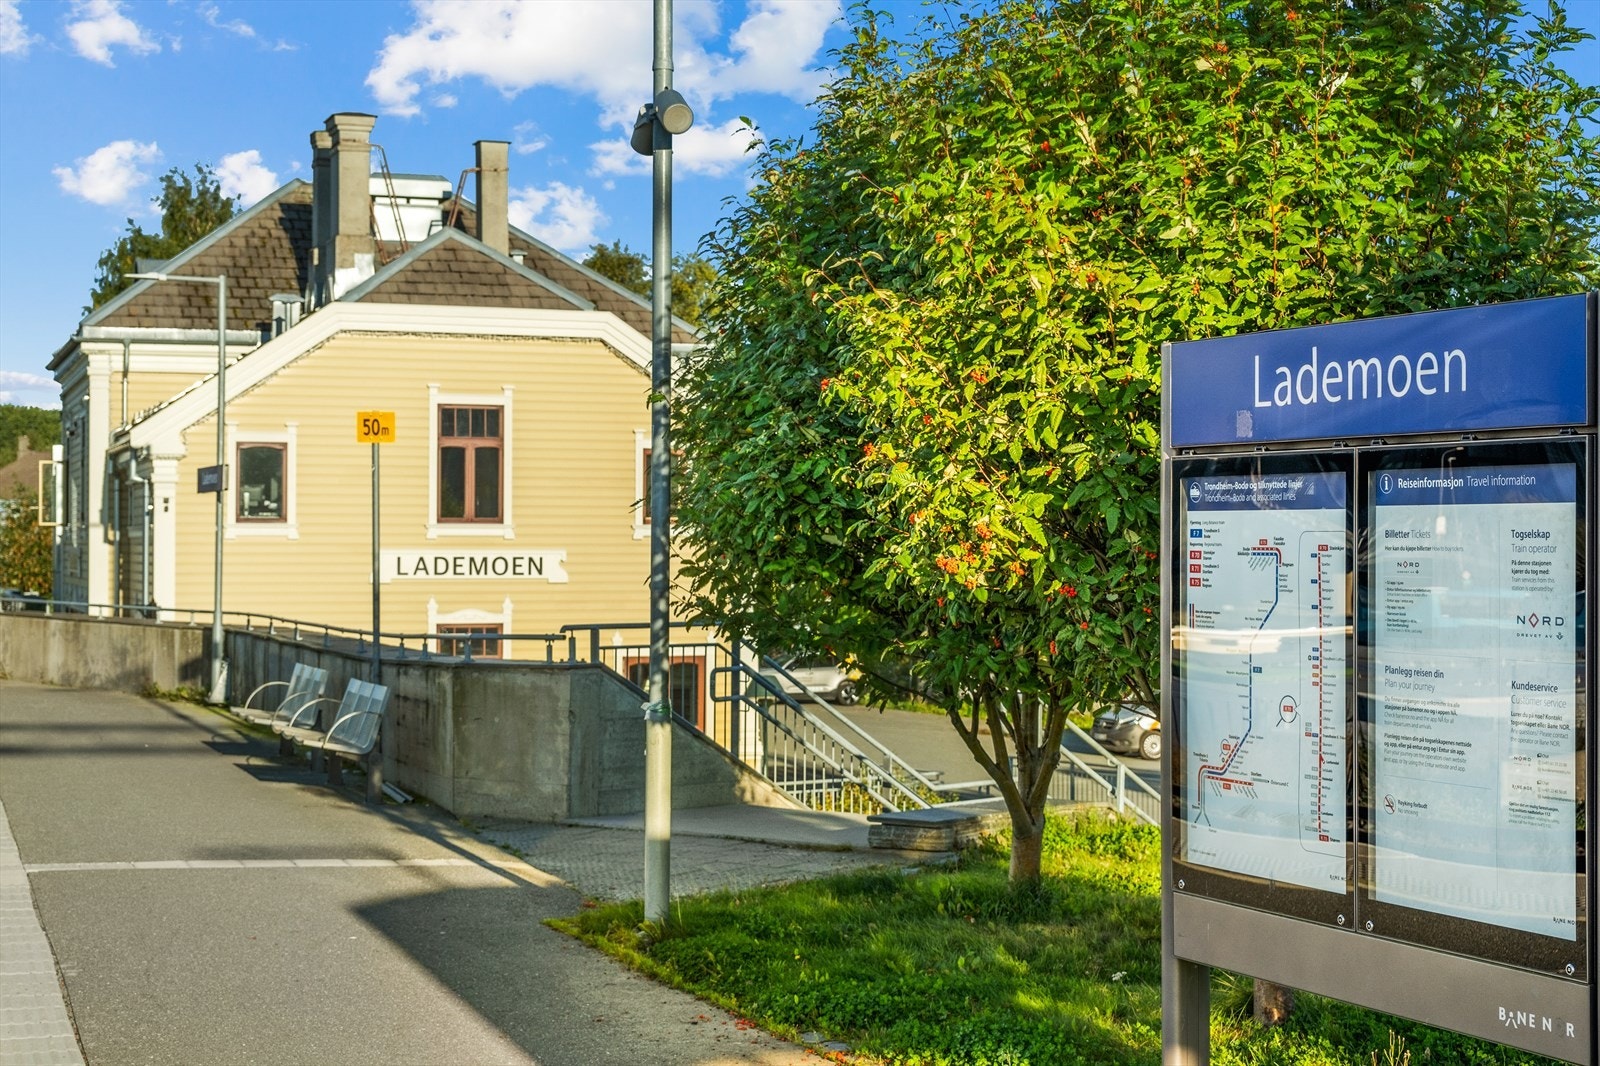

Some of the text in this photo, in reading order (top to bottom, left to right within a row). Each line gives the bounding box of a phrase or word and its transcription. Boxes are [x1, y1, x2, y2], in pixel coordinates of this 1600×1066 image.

[1254, 346, 1467, 408] Lademoen
[1250, 482, 1258, 491] og
[1258, 480, 1287, 490] tilknyttede
[1398, 474, 1536, 489] Reiseinformasjon Travel information
[1246, 492, 1256, 502] and
[1282, 491, 1296, 500] lines
[1385, 529, 1431, 539] Billetter Tickets
[1511, 530, 1550, 540] Togselskap
[1512, 544, 1557, 554] Train operator
[397, 556, 544, 576] LADEMOEN
[1516, 612, 1564, 628] NORD
[1385, 665, 1444, 678] Planlegg reisen din
[1385, 679, 1435, 693] Plan your journey
[1512, 681, 1558, 693] Kundeservice
[1511, 695, 1566, 708] Customer service
[1398, 800, 1412, 808] Røyking
[1499, 1006, 1536, 1029] BANE
